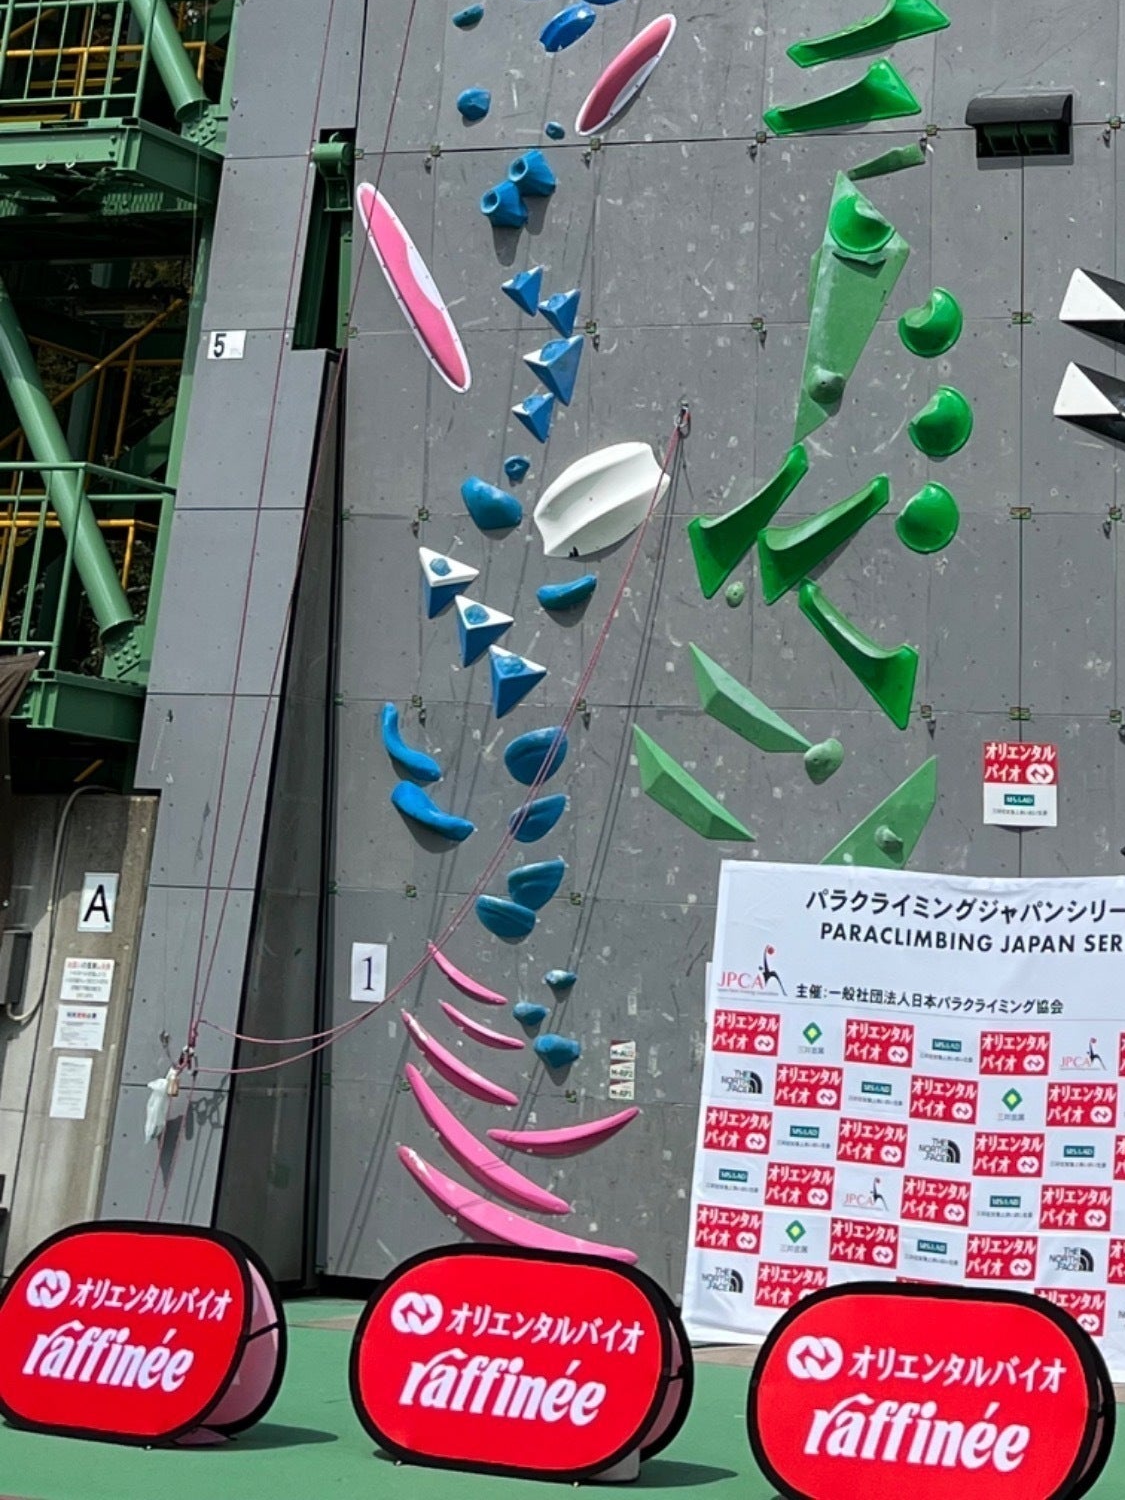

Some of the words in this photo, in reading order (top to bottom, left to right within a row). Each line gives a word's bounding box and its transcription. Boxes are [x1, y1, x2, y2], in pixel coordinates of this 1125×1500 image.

[214, 333, 226, 357] 5
[985, 742, 1056, 762] オリエンタル
[984, 763, 1021, 782] バイオ
[83, 884, 110, 922] A
[820, 922, 993, 952] PARACLIMBING
[1000, 934, 1076, 954] JAPAN
[362, 956, 375, 991] 1
[718, 971, 764, 990] JPCA
[715, 1011, 779, 1032] オリエンタル
[713, 1031, 749, 1050] バイオ
[846, 1021, 913, 1043] オリエンタル
[981, 1033, 1049, 1051] オリエンタル
[844, 1041, 882, 1061] バイオ
[979, 1054, 1017, 1072] バイオ
[1061, 1056, 1092, 1068] JPCA
[777, 1065, 842, 1086] オリエンタル
[775, 1086, 811, 1104] バイオ
[912, 1077, 977, 1099] オリエンタル
[1048, 1084, 1116, 1103] オリエンタル
[910, 1098, 946, 1118] バイオ
[1046, 1105, 1084, 1123] バイオ
[707, 1108, 771, 1130] オリエンタル
[705, 1129, 740, 1148] バイオ
[839, 1120, 906, 1143] オリエンタル
[837, 1141, 875, 1160] バイオ
[975, 1134, 1043, 1153] オリエンタル
[973, 1155, 1011, 1173] バイオ
[767, 1164, 834, 1185] オリエンタル
[765, 1185, 802, 1205] バイオ
[844, 1193, 875, 1205] JPCA
[903, 1177, 970, 1201] オリエンタル
[1042, 1186, 1111, 1206] オリエンタル
[698, 1206, 762, 1229] オリエンタル
[901, 1199, 939, 1219] バイオ
[1040, 1208, 1078, 1226] バイオ
[696, 1227, 731, 1247] バイオ
[830, 1221, 898, 1243] オリエンタル
[829, 1240, 867, 1261] バイオ
[967, 1236, 1037, 1255] オリエンタル
[759, 1265, 827, 1286] オリエンタル
[965, 1257, 1004, 1276] バイオ
[70, 1277, 232, 1321] オリエンタルバイオ
[756, 1286, 793, 1305] バイオ
[446, 1302, 645, 1354] オリエンタルバイオ
[22, 1319, 194, 1392] raffinée
[847, 1344, 1067, 1393] オリエンタルバイオ
[398, 1347, 606, 1426] raffinée
[804, 1393, 1030, 1472] raffinée
